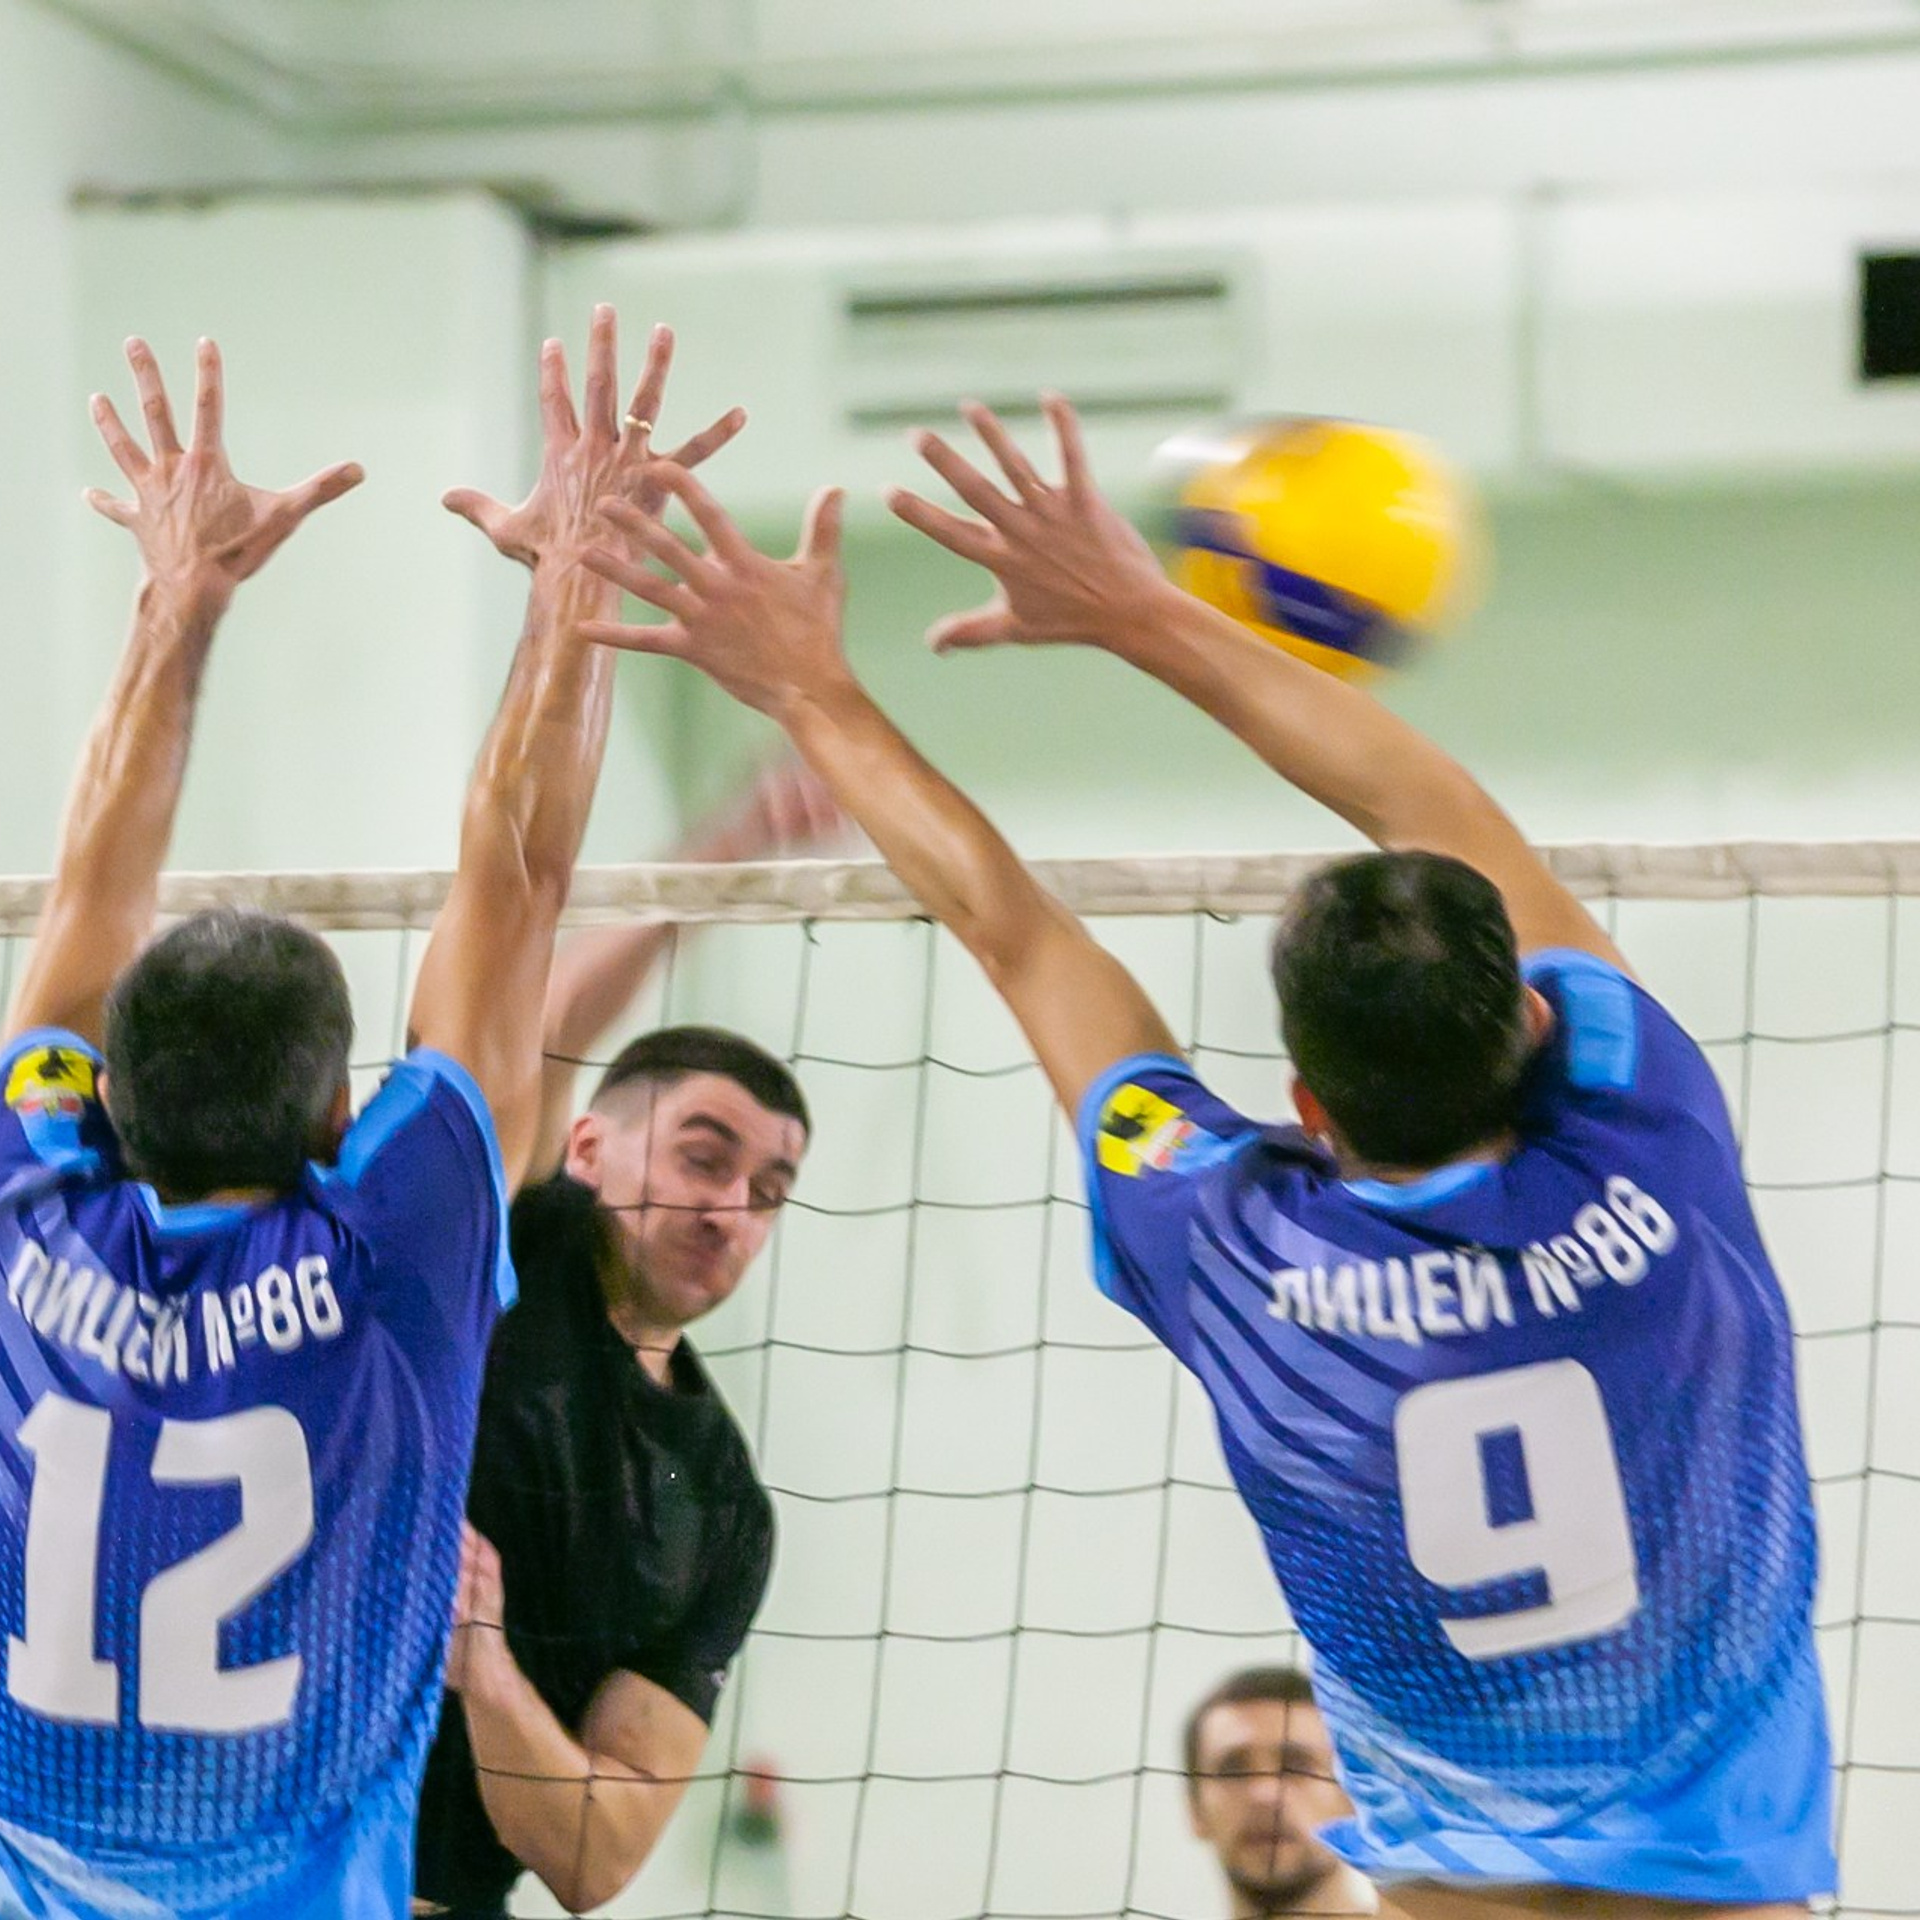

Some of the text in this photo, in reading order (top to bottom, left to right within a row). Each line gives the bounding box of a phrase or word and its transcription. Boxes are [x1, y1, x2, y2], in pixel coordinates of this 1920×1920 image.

[1265, 1244, 1517, 1347] ЛИЦЕЙ
[7, 1390, 316, 1735] 12
[1393, 1357, 1641, 1661] 9
